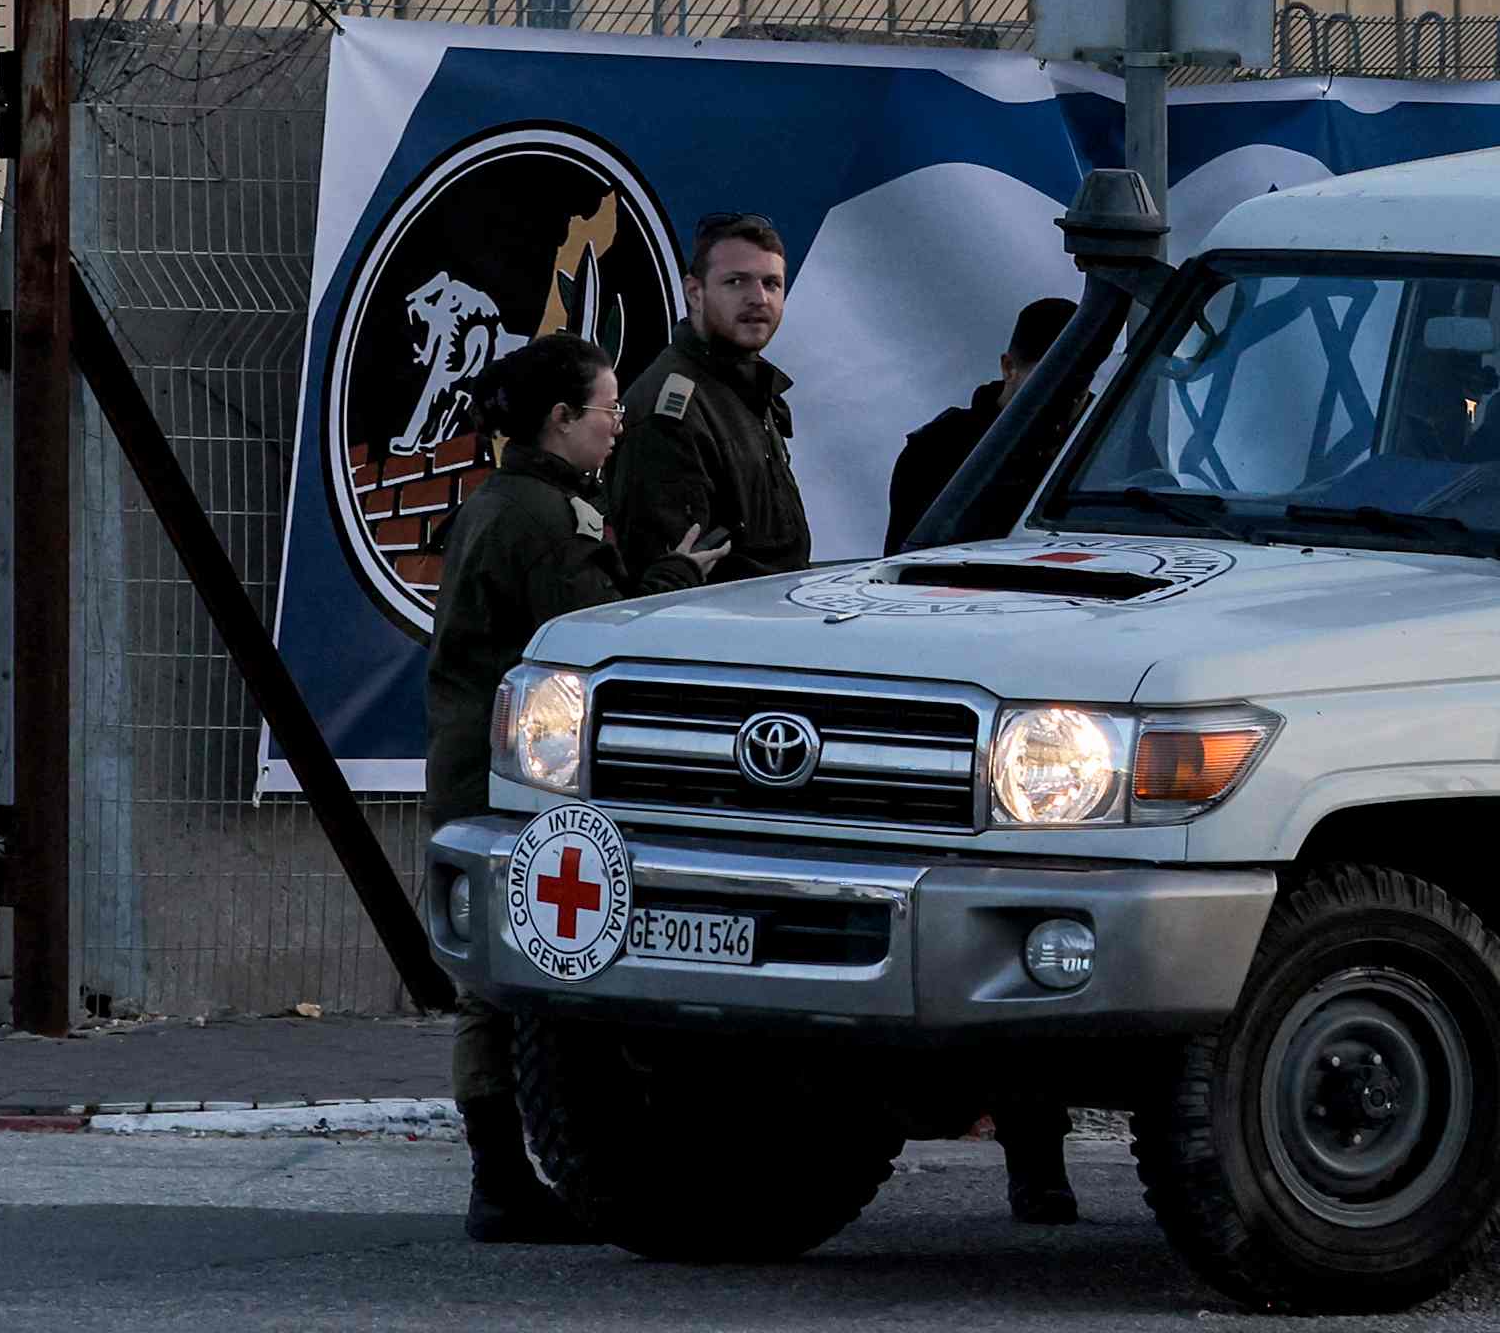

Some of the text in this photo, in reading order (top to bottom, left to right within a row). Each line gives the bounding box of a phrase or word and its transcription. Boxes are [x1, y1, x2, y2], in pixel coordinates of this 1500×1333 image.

[802, 593, 1000, 614] GENEVE
[547, 809, 627, 944] INTERNATIONAL
[527, 936, 602, 976] GENEVE
